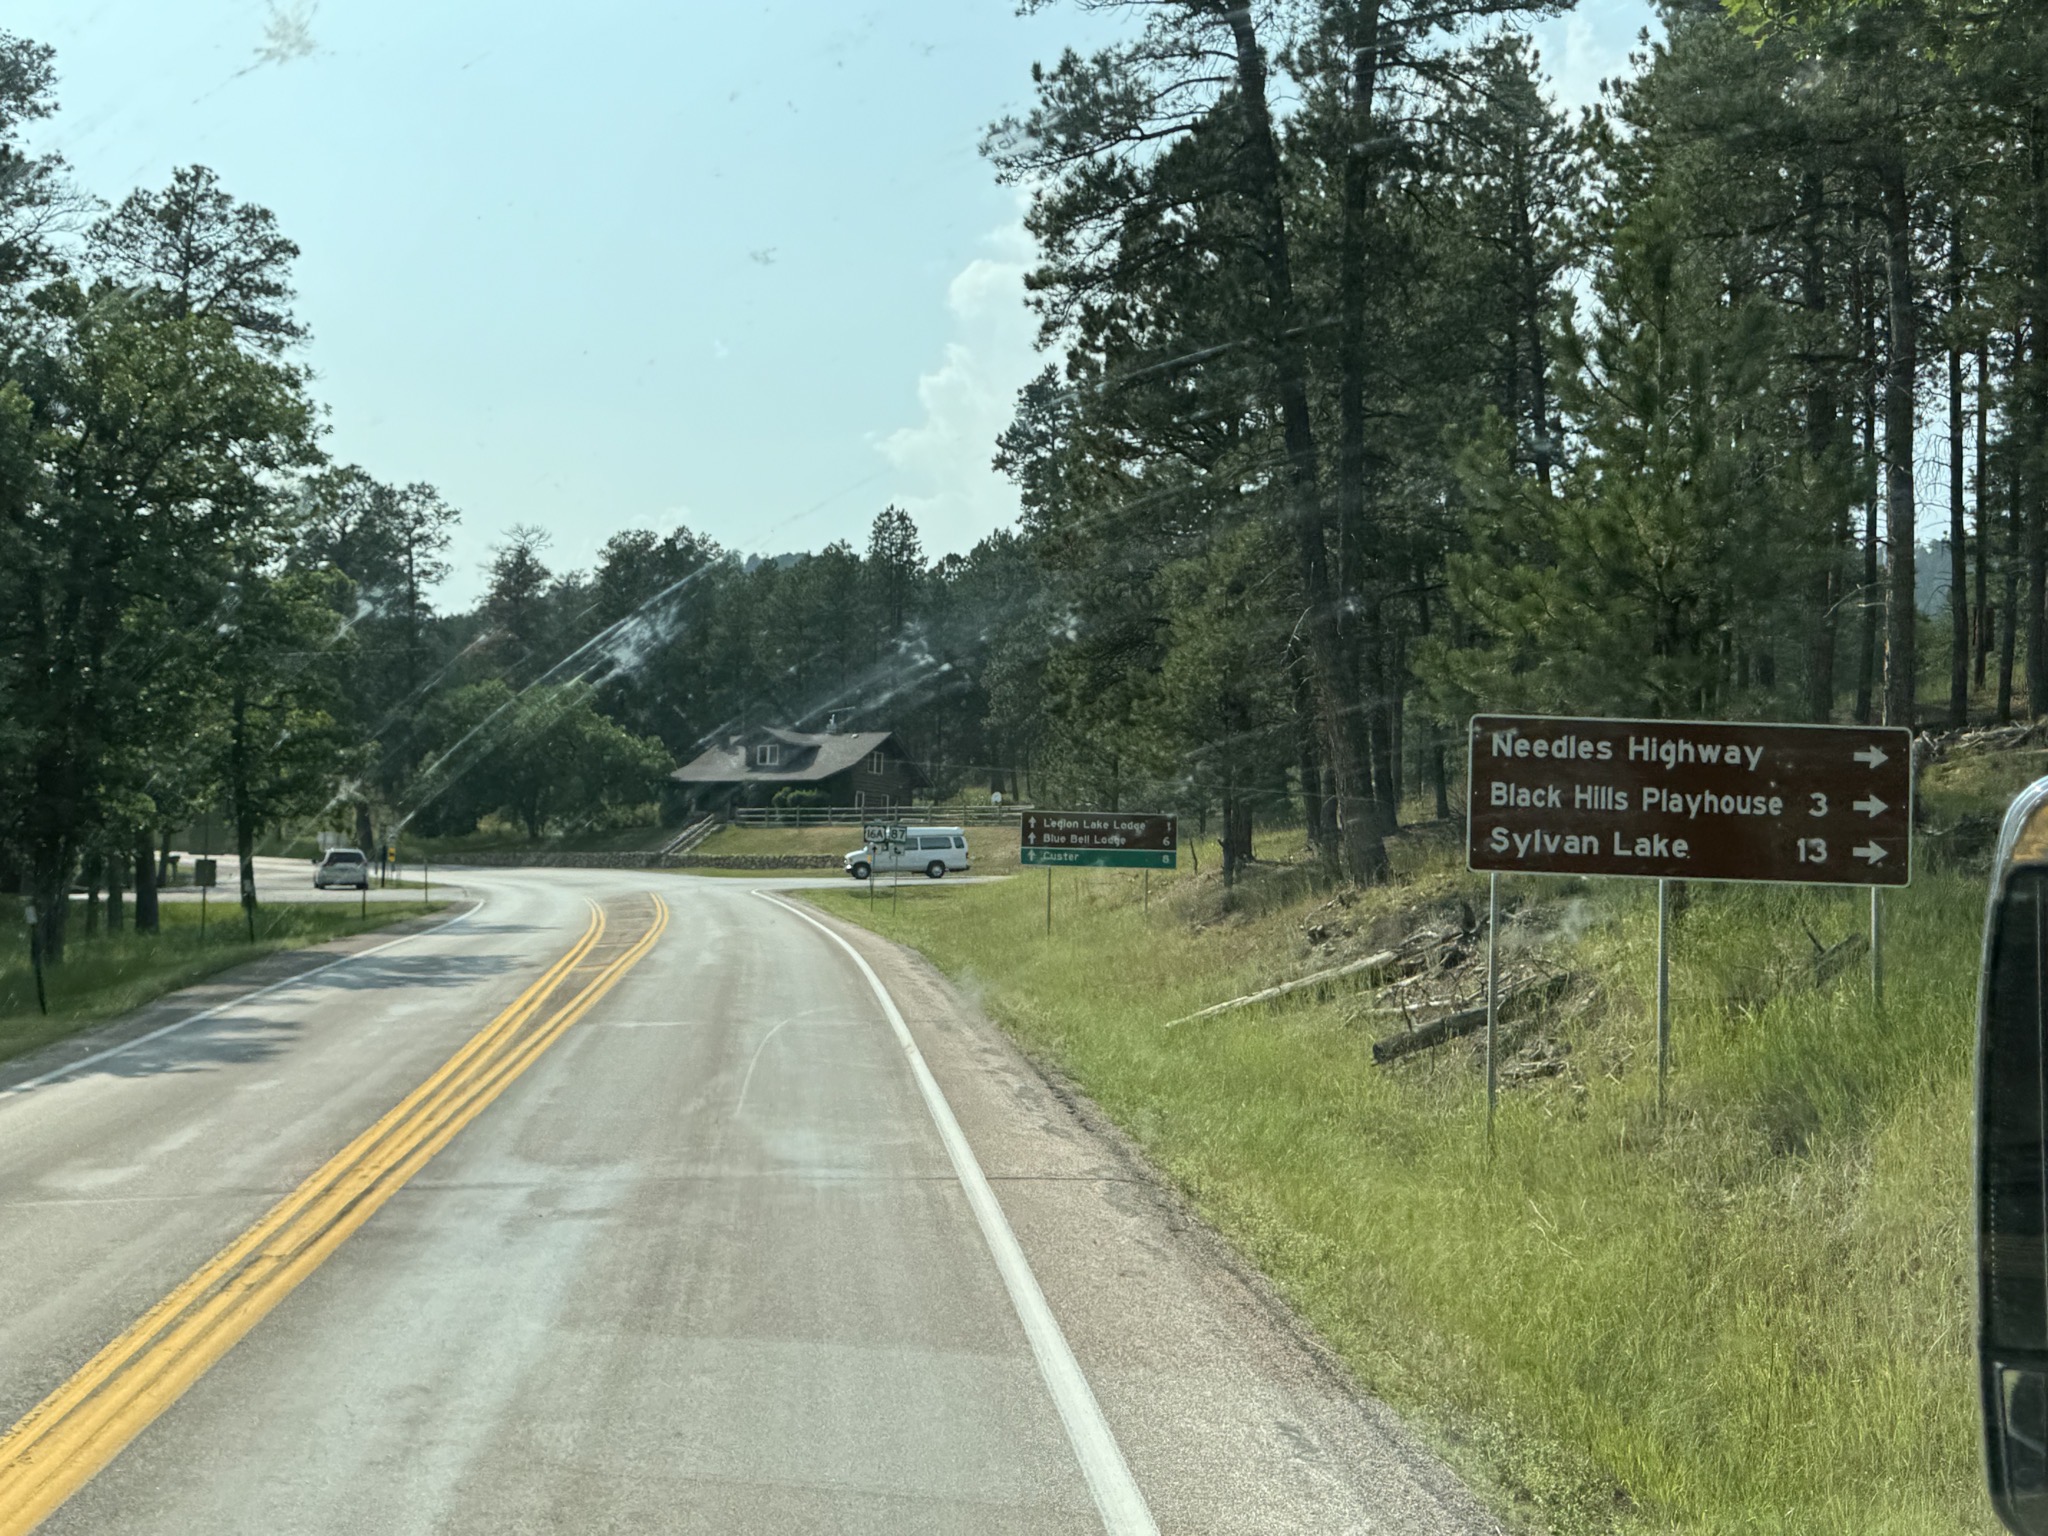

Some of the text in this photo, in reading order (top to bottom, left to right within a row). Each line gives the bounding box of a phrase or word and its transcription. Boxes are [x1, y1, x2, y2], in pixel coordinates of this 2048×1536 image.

[1491, 734, 1764, 771] Needles Highway
[1490, 781, 1829, 820] Black Hills Playhouse 3
[1043, 818, 1079, 831] Legion
[1083, 819, 1109, 830] Lake
[1113, 820, 1146, 832] Lodge
[867, 829, 883, 839] 16A
[891, 829, 906, 839] 87
[1043, 833, 1170, 847] Blue Bell Lodge 6
[1490, 826, 1828, 863] Sylvan Lake 13
[1043, 851, 1079, 861] Custer
